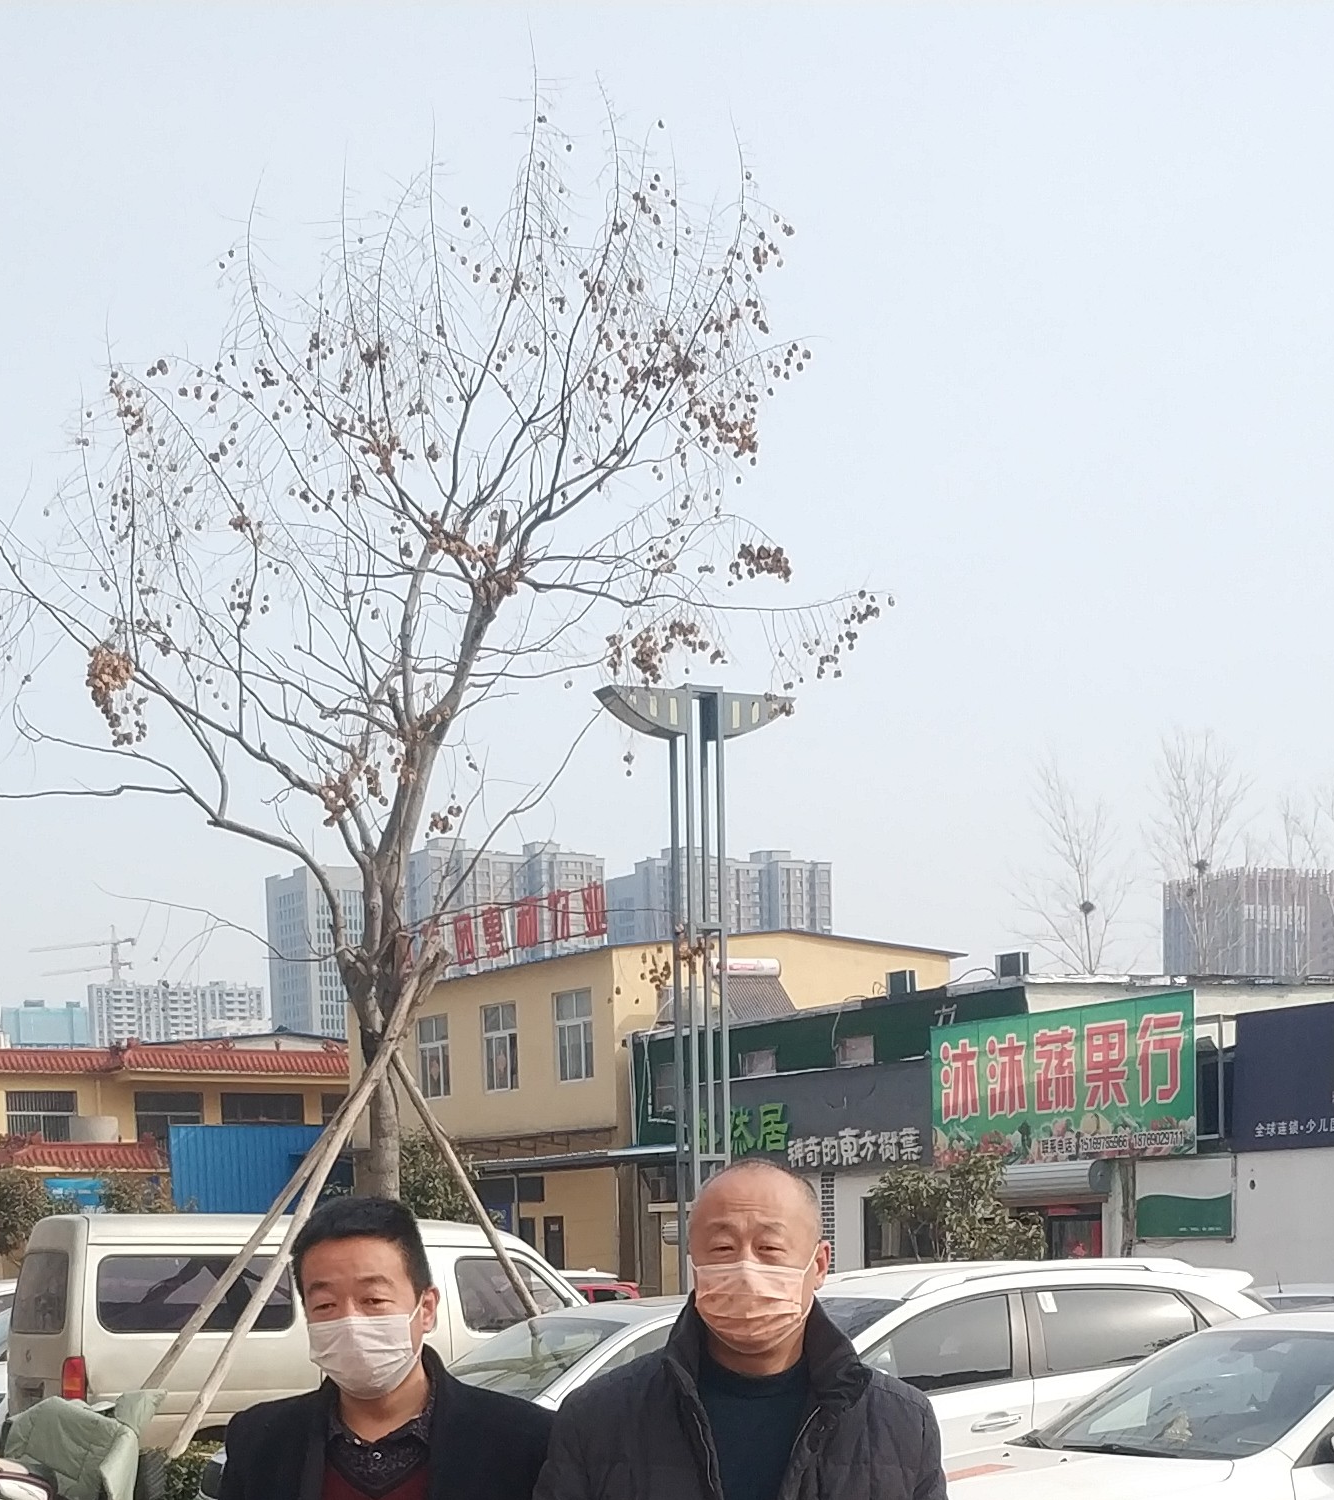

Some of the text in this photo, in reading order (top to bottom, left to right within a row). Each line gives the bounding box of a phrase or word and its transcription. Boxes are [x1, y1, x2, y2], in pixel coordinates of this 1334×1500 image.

[940, 1011, 1185, 1123] 沐沐蔬果行
